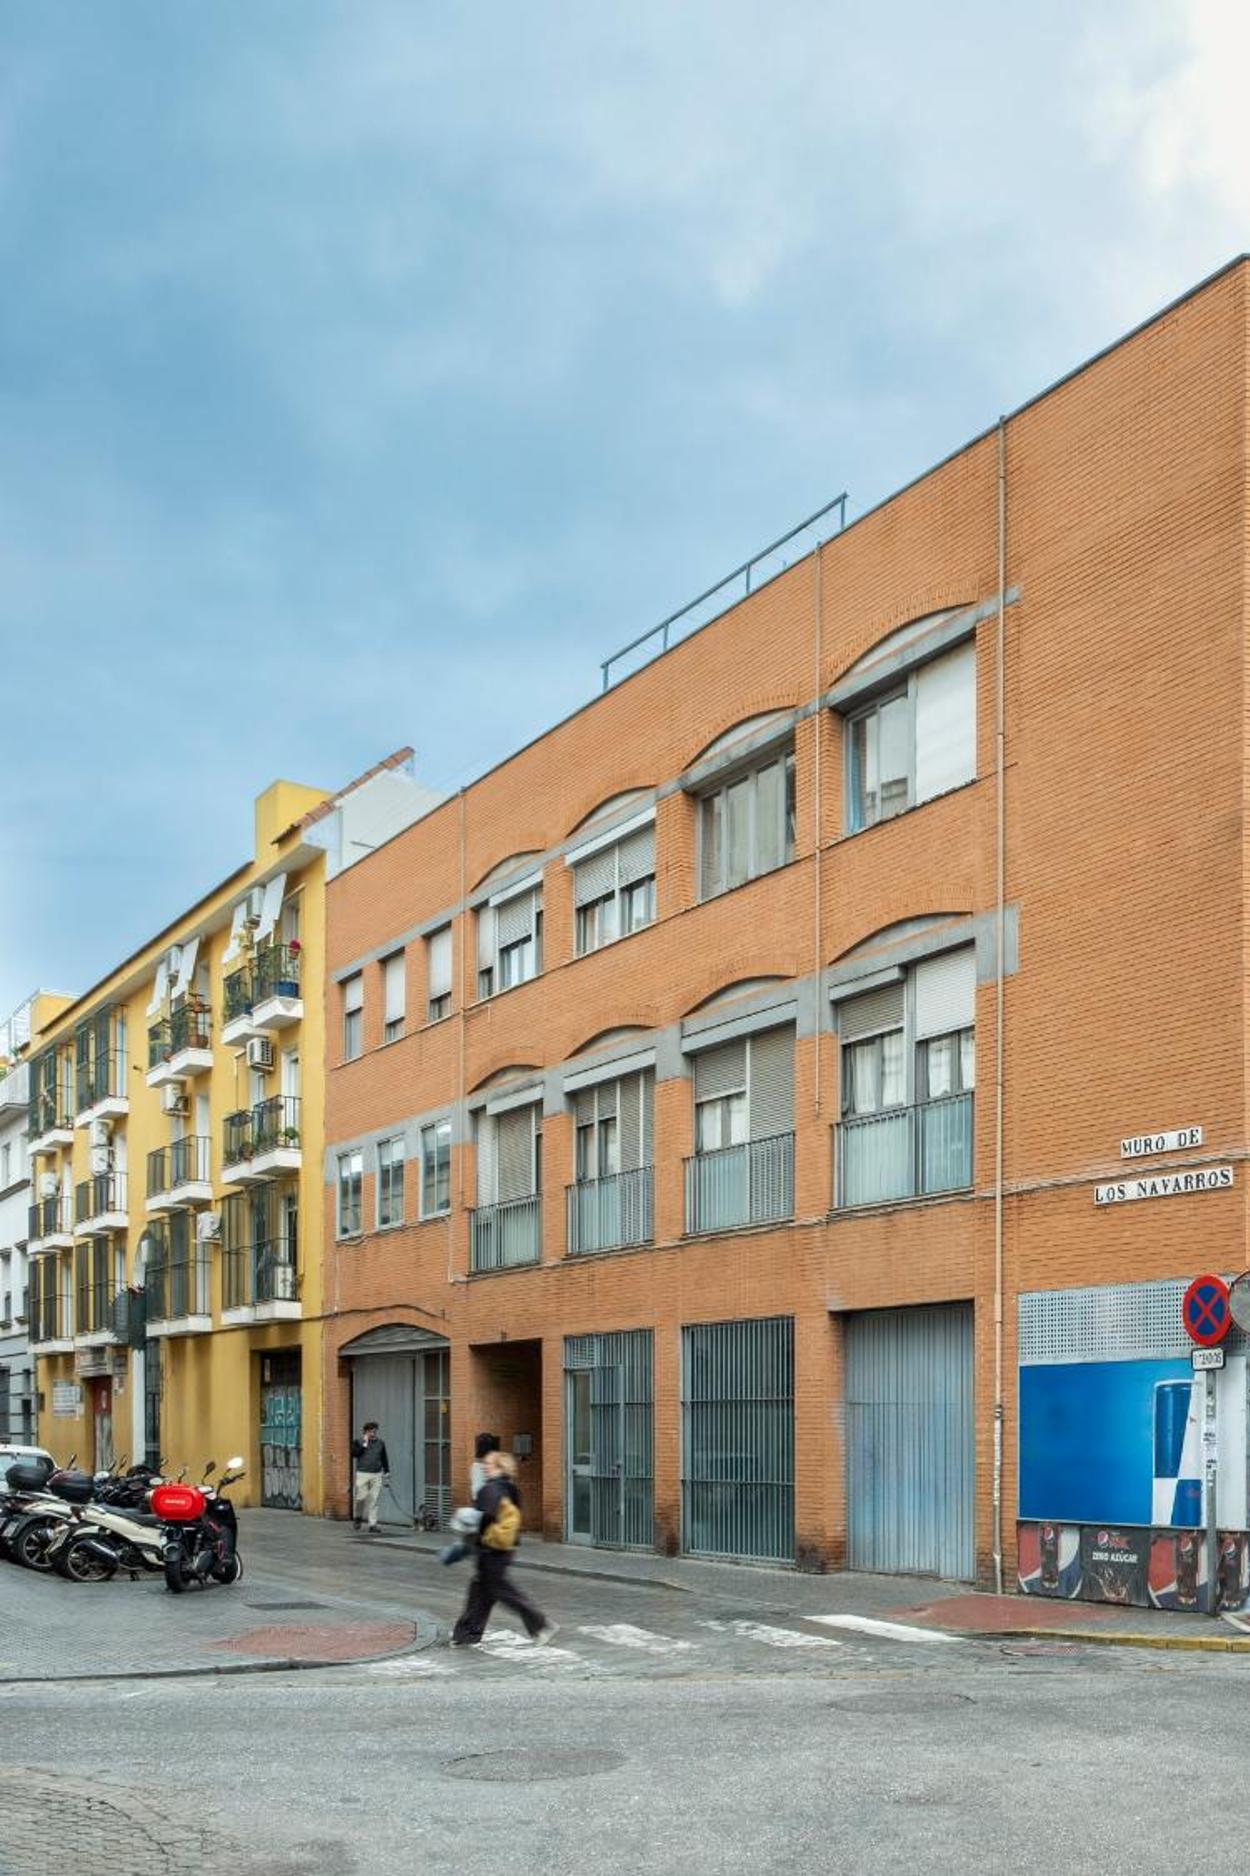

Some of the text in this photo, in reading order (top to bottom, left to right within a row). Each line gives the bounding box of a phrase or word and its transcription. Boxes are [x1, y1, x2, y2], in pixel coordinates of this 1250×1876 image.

[1122, 1129, 1199, 1154] MURO DE
[1095, 1169, 1231, 1202] LOS NAVARROS
